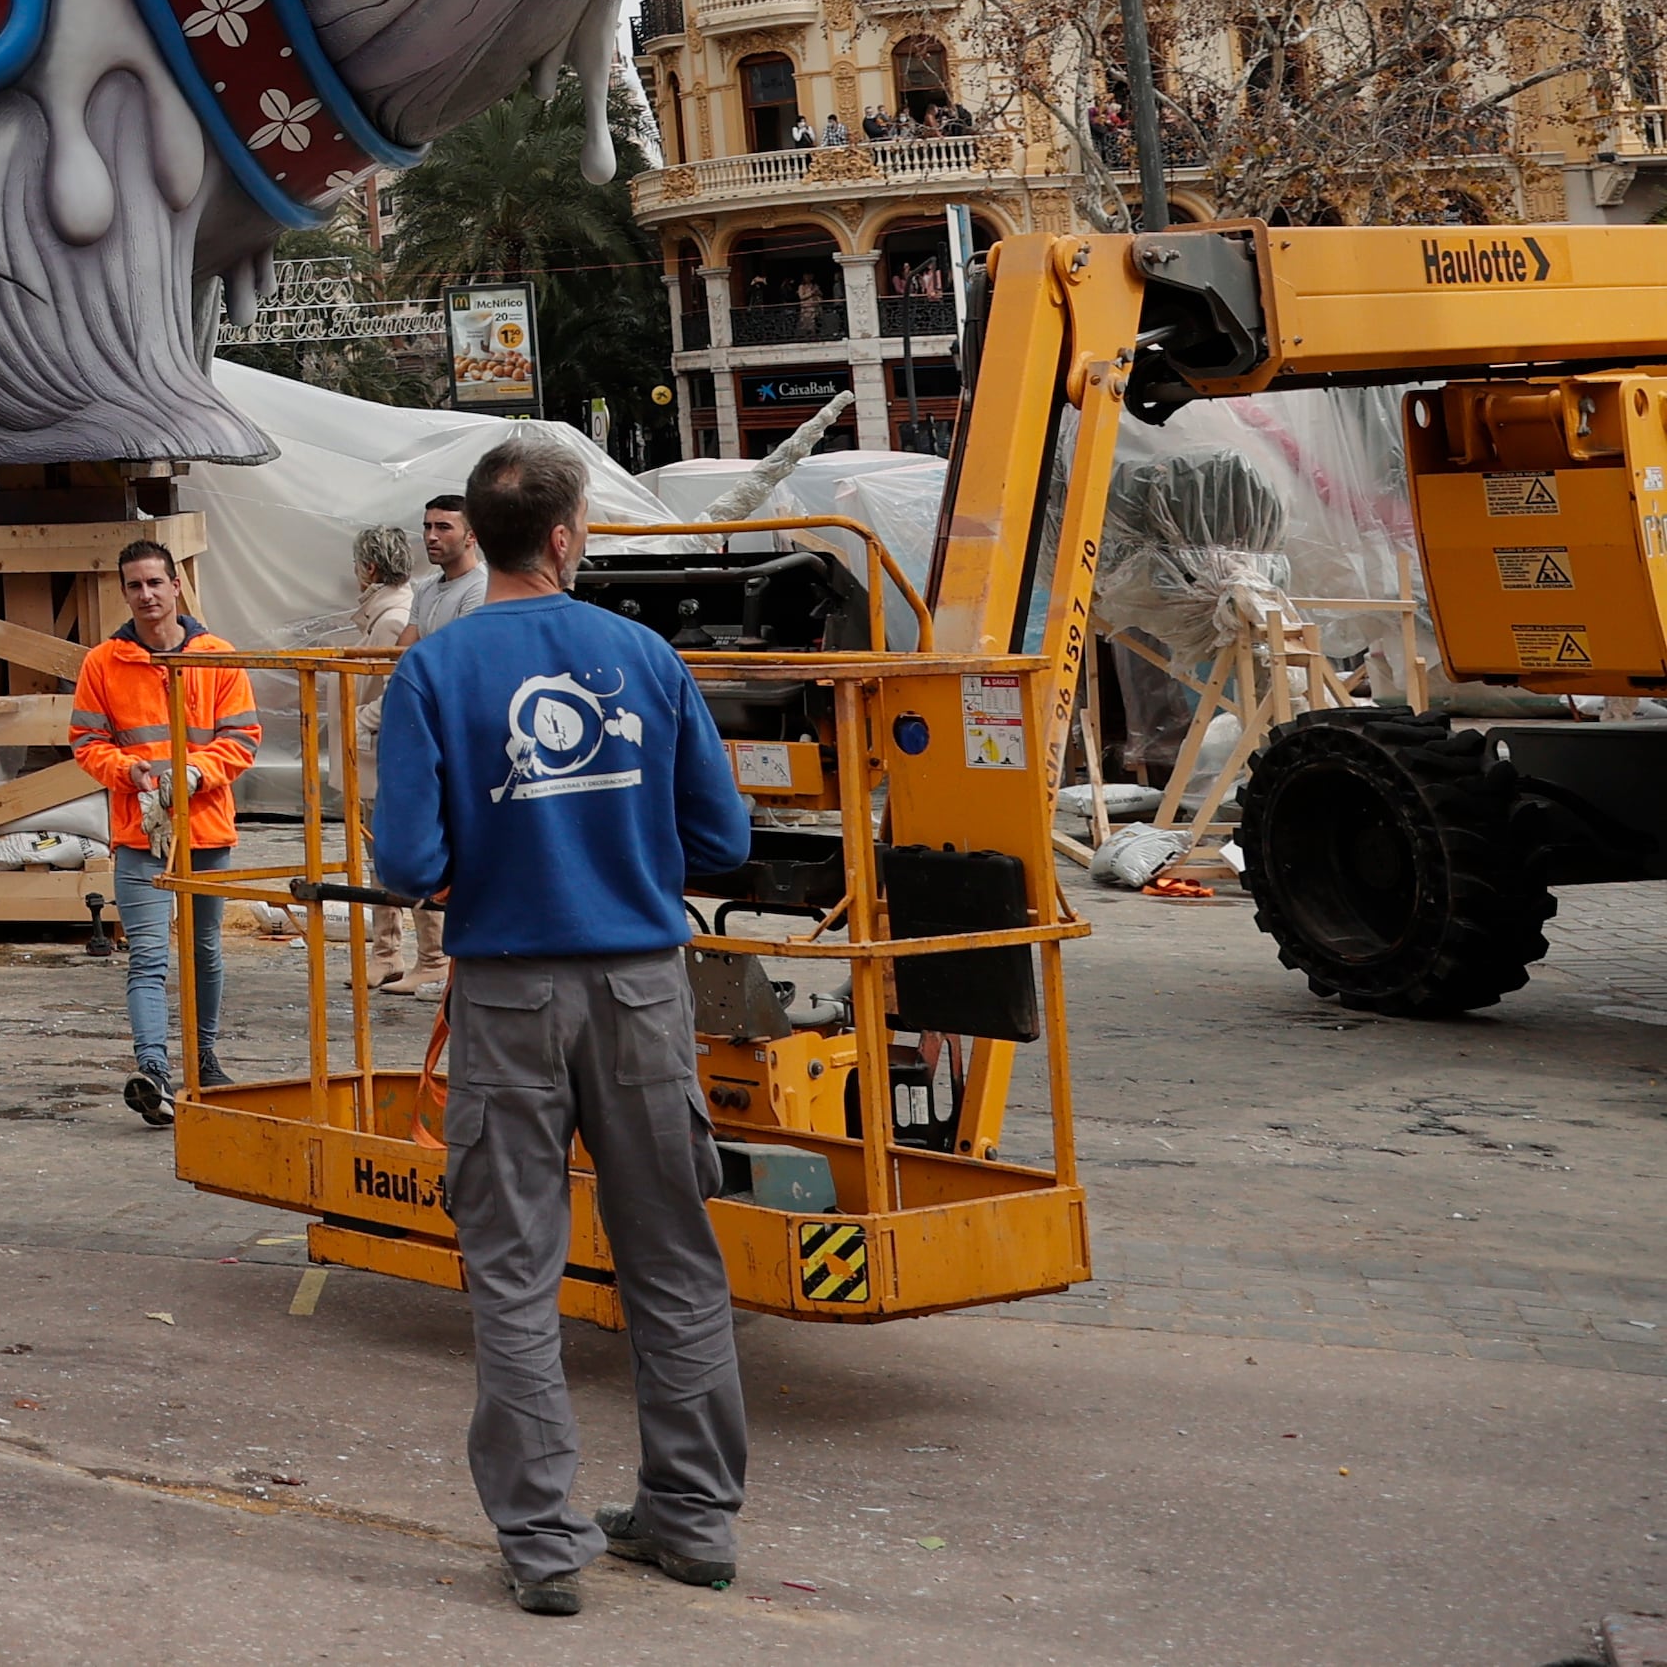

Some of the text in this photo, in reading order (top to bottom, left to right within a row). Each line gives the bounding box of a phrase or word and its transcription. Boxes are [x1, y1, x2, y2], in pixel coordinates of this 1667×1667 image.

[1421, 238, 1528, 284] Haulotte
[495, 312, 508, 322] 20
[778, 380, 837, 396] CaixaBank
[1080, 539, 1097, 575] 70
[1063, 624, 1081, 674] 159
[992, 677, 1017, 686] DANGER
[1056, 686, 1072, 722] 96
